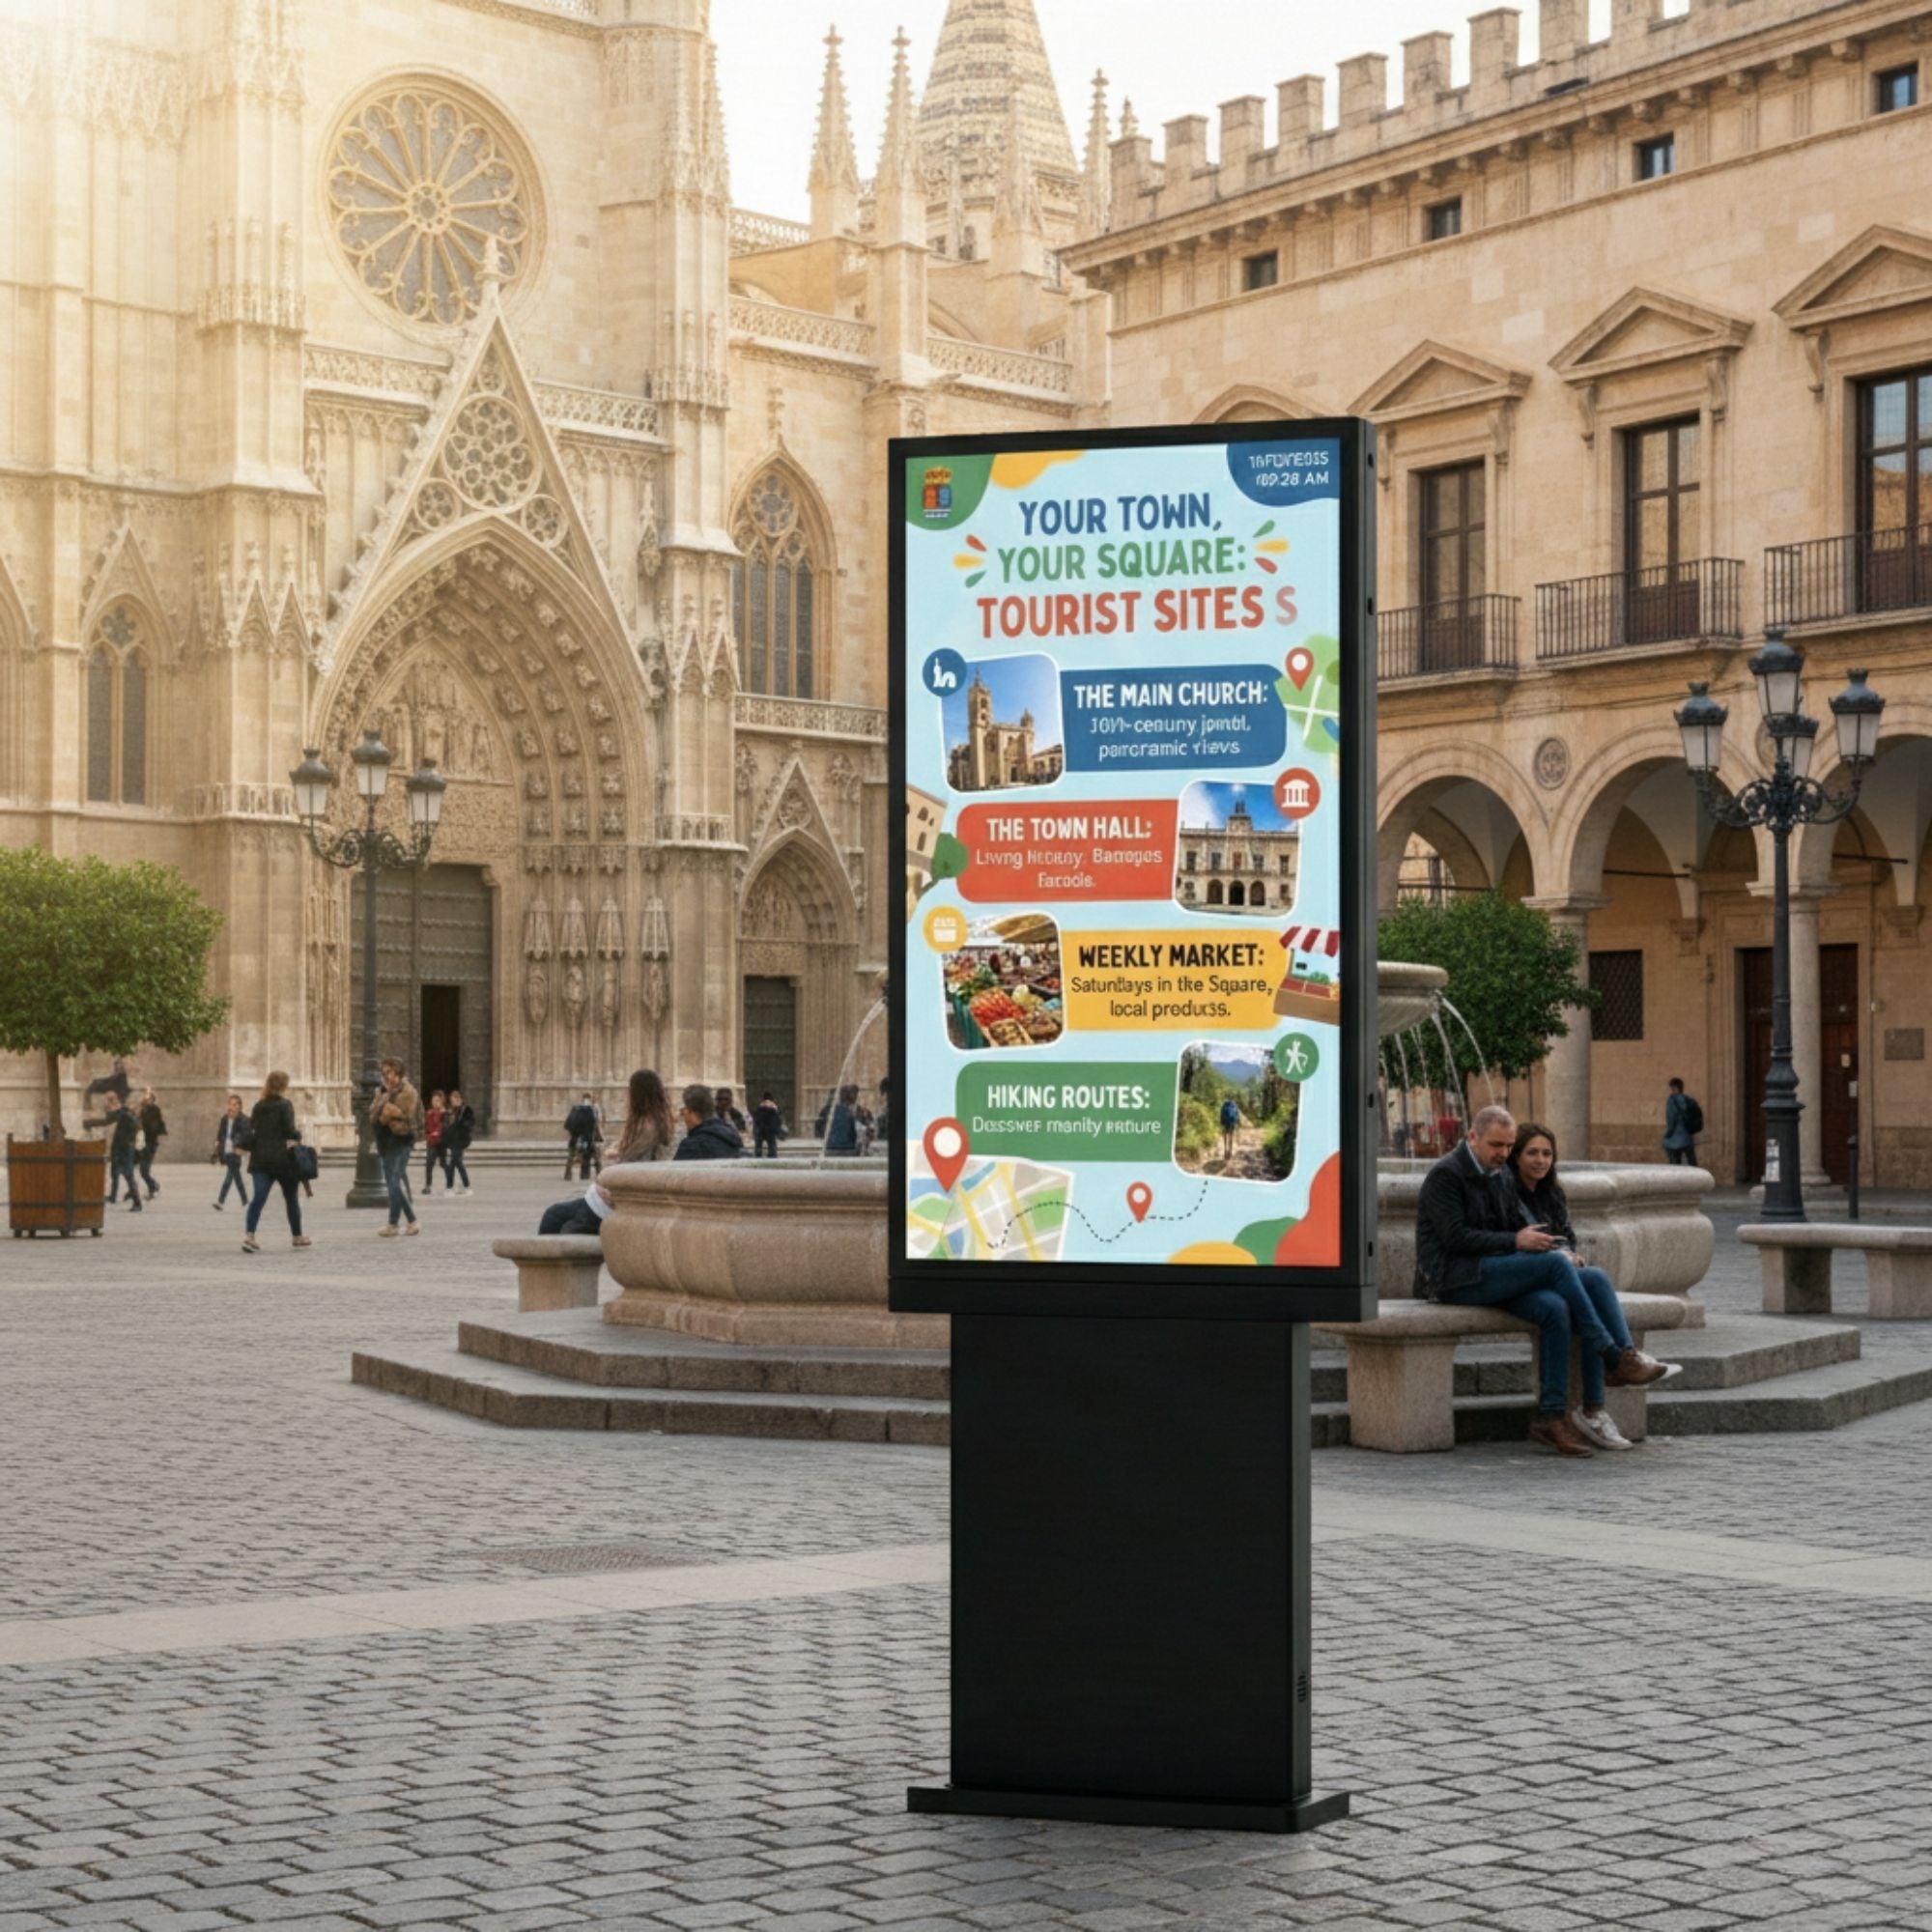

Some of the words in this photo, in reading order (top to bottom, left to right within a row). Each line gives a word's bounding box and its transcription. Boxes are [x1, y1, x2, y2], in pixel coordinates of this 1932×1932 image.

[1305, 470, 1329, 485] AM
[1019, 499, 1106, 535] YOUR
[1118, 493, 1222, 530] TOWN,
[997, 543, 1085, 582] YOUR
[1097, 537, 1246, 580] SQUARE:
[977, 591, 1141, 639] TOURIST
[1153, 585, 1264, 633] SITES
[1276, 586, 1297, 625] S
[1073, 684, 1115, 709] THE
[1121, 683, 1174, 707] MAIN
[1179, 681, 1268, 706] CHURCH:
[986, 818, 1025, 841] THE
[1030, 817, 1088, 840] TOWN
[1094, 816, 1152, 839] HALL:
[1079, 945, 1163, 968] WEEKLY
[1169, 943, 1264, 967] MARKET:
[1157, 977, 1173, 992] in
[1208, 975, 1273, 996] Square,
[1110, 1000, 1148, 1016] local
[987, 1085, 1056, 1109] HIKING
[1062, 1085, 1151, 1109] ROUTES:
